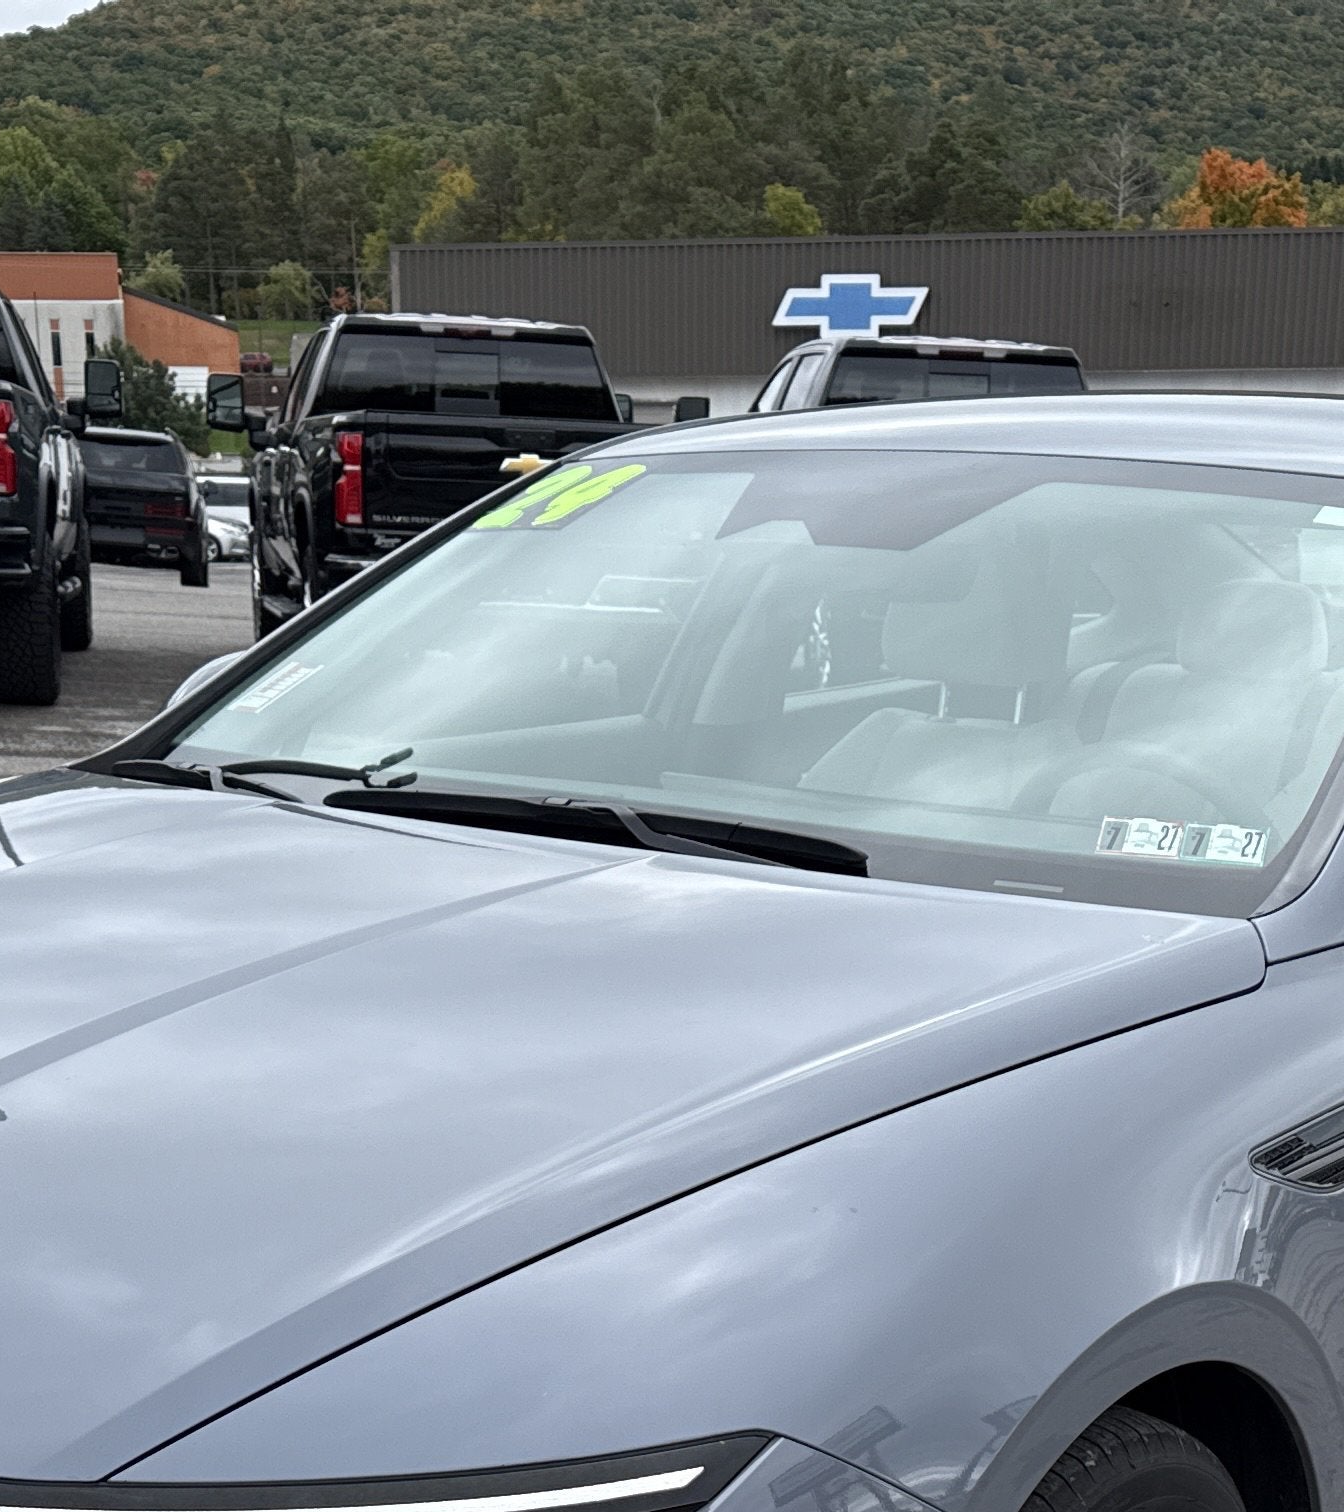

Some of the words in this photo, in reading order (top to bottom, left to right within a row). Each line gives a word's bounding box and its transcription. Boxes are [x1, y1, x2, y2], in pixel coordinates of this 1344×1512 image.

[372, 514, 446, 523] SILVERAD
[1156, 824, 1180, 852] 27
[1240, 831, 1264, 859] 27
